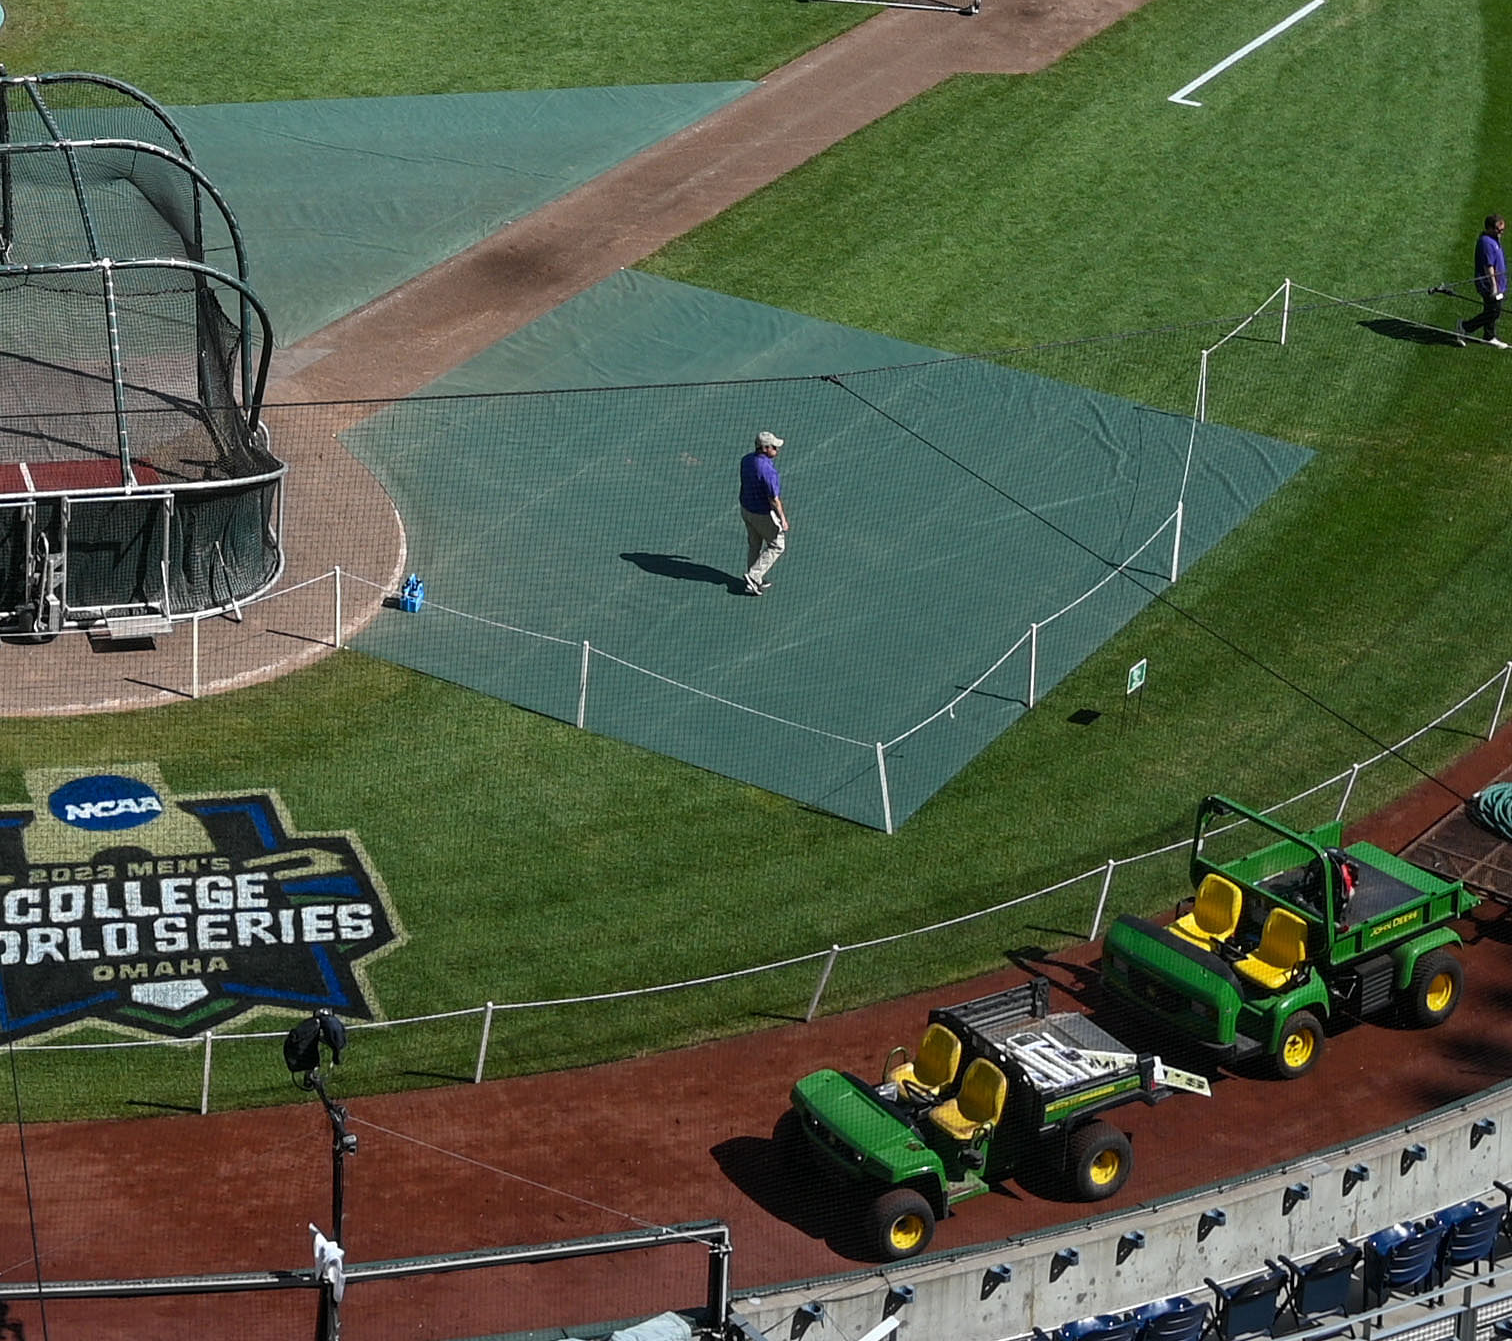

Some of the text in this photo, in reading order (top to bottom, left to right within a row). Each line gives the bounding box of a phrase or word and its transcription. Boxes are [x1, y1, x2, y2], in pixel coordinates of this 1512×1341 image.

[64, 796, 163, 821] NCAA
[28, 857, 231, 884] 2023 MEN'S
[3, 872, 270, 925] COLLEGE
[154, 902, 374, 954] SERIES
[1370, 911, 1418, 937] JOHN DEERE
[92, 955, 231, 982] OMAHA
